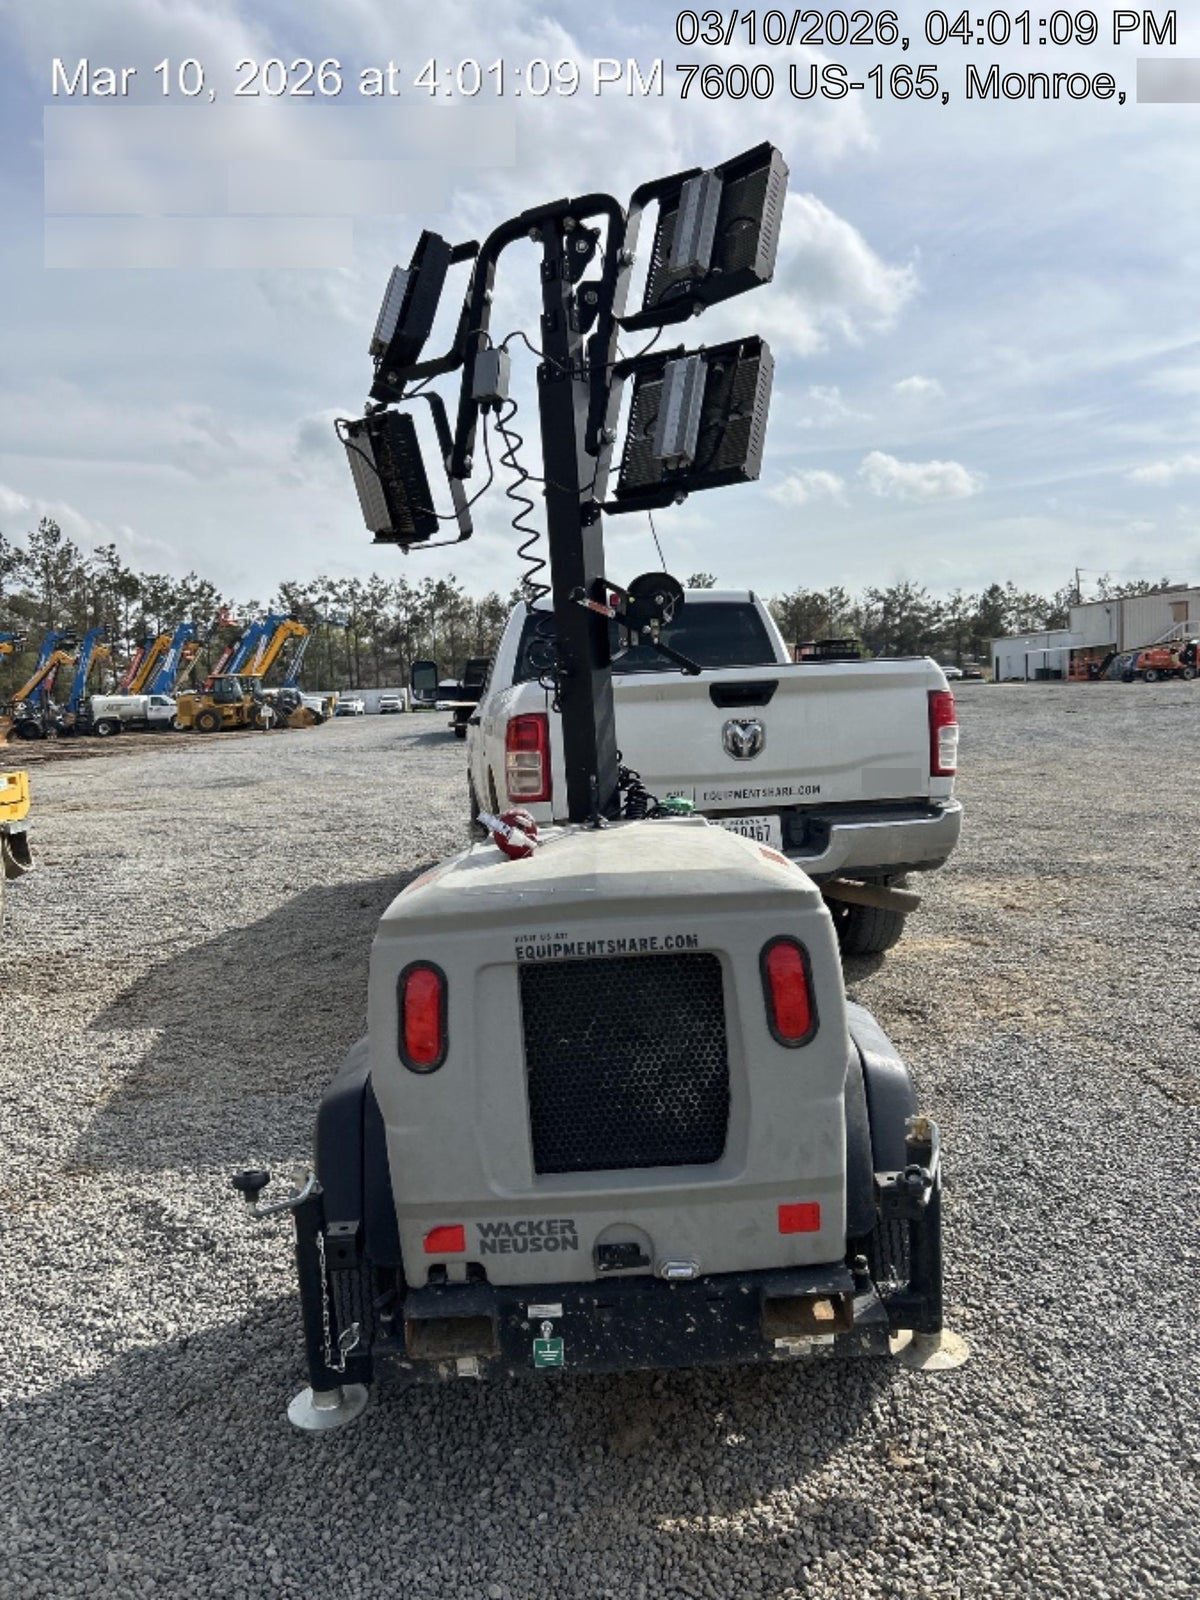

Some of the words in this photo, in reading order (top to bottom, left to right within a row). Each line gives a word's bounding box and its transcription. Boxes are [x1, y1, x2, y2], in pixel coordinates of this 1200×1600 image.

[514, 935, 537, 943] VISIT
[540, 933, 552, 941] US
[516, 935, 698, 960] EQUIPMENTSHARE.COM
[476, 1219, 579, 1238] WACKER
[479, 1235, 579, 1255] NEUSON
